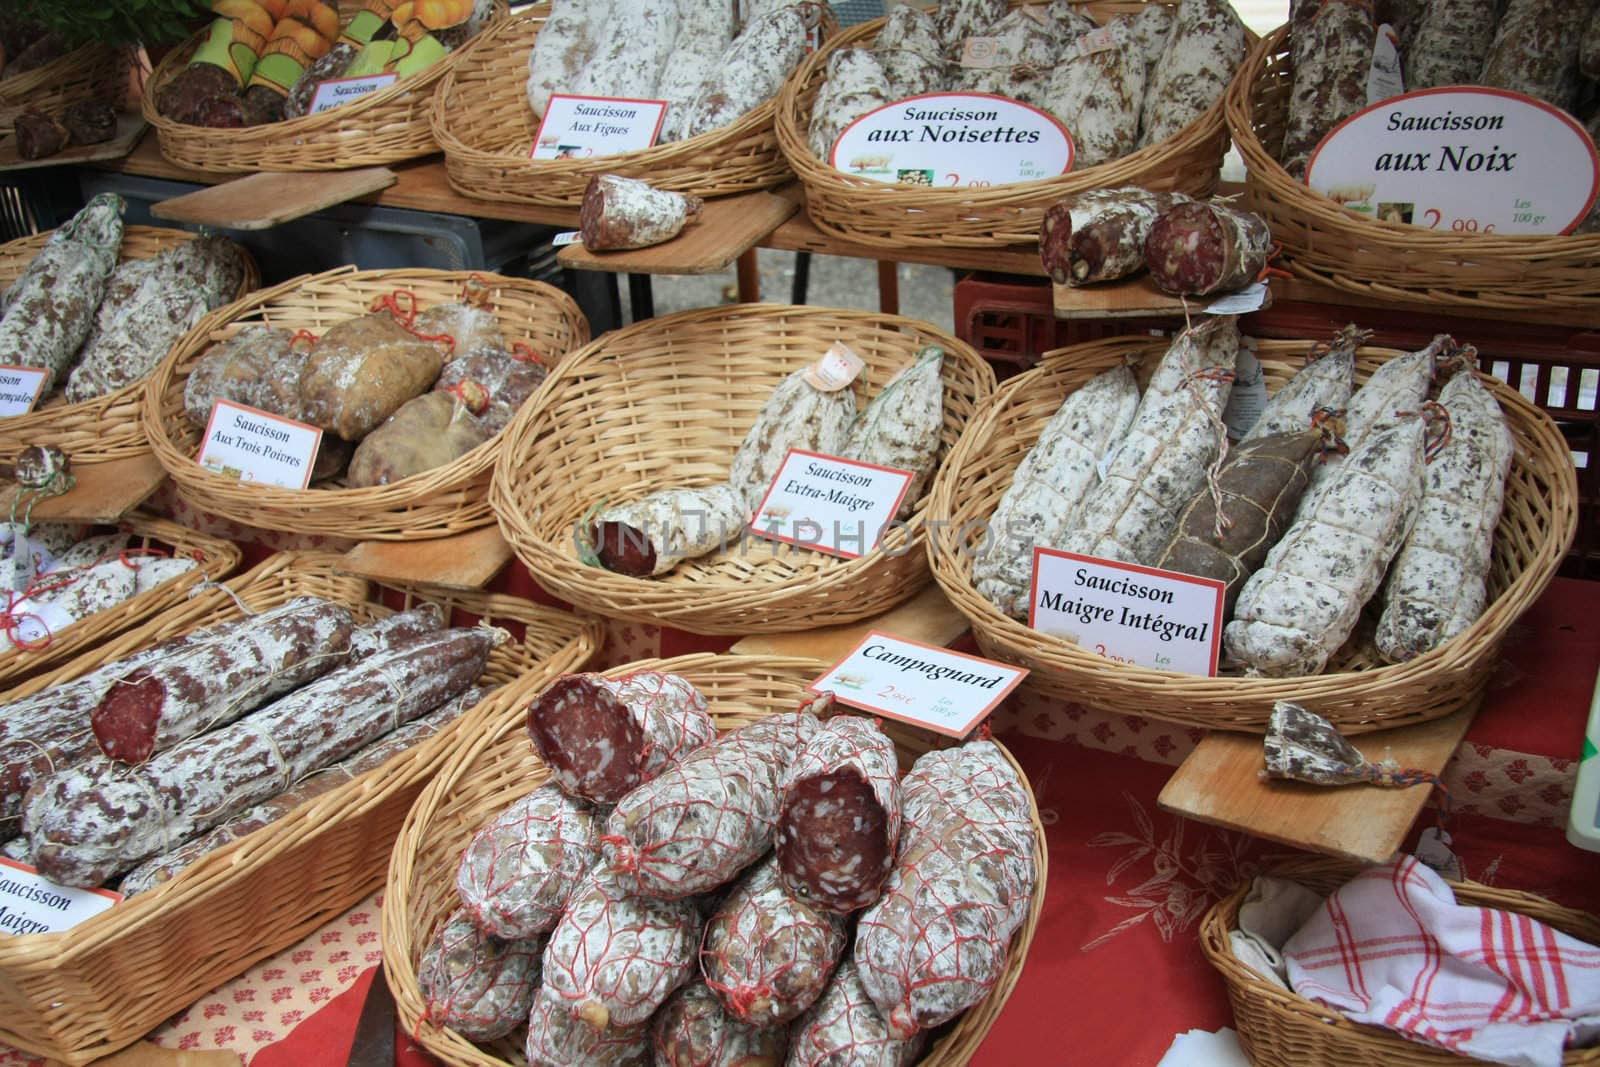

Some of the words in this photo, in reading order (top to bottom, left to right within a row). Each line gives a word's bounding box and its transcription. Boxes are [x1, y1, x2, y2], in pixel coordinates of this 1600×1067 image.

[332, 83, 377, 97] Saucisson
[574, 103, 637, 119] Saucisson
[903, 107, 998, 122] Saucisson
[1387, 111, 1504, 131] Saucisson
[569, 121, 591, 132] Aux
[593, 122, 630, 137] Figues
[867, 127, 913, 143] aux
[920, 125, 1041, 144] Noisettes
[1374, 154, 1430, 173] aux
[1436, 145, 1517, 173] Noix
[233, 414, 291, 443] Saucisson
[211, 429, 232, 446] Aux
[235, 436, 262, 457] Trois
[262, 444, 302, 468] Poivres
[804, 462, 873, 488] Saucisson
[783, 479, 875, 513] Extra-Maigre
[1074, 568, 1175, 605] Saucisson
[1039, 589, 1115, 625] Maigre
[1119, 606, 1209, 643] Intégral
[862, 644, 1004, 690] Campagnard
